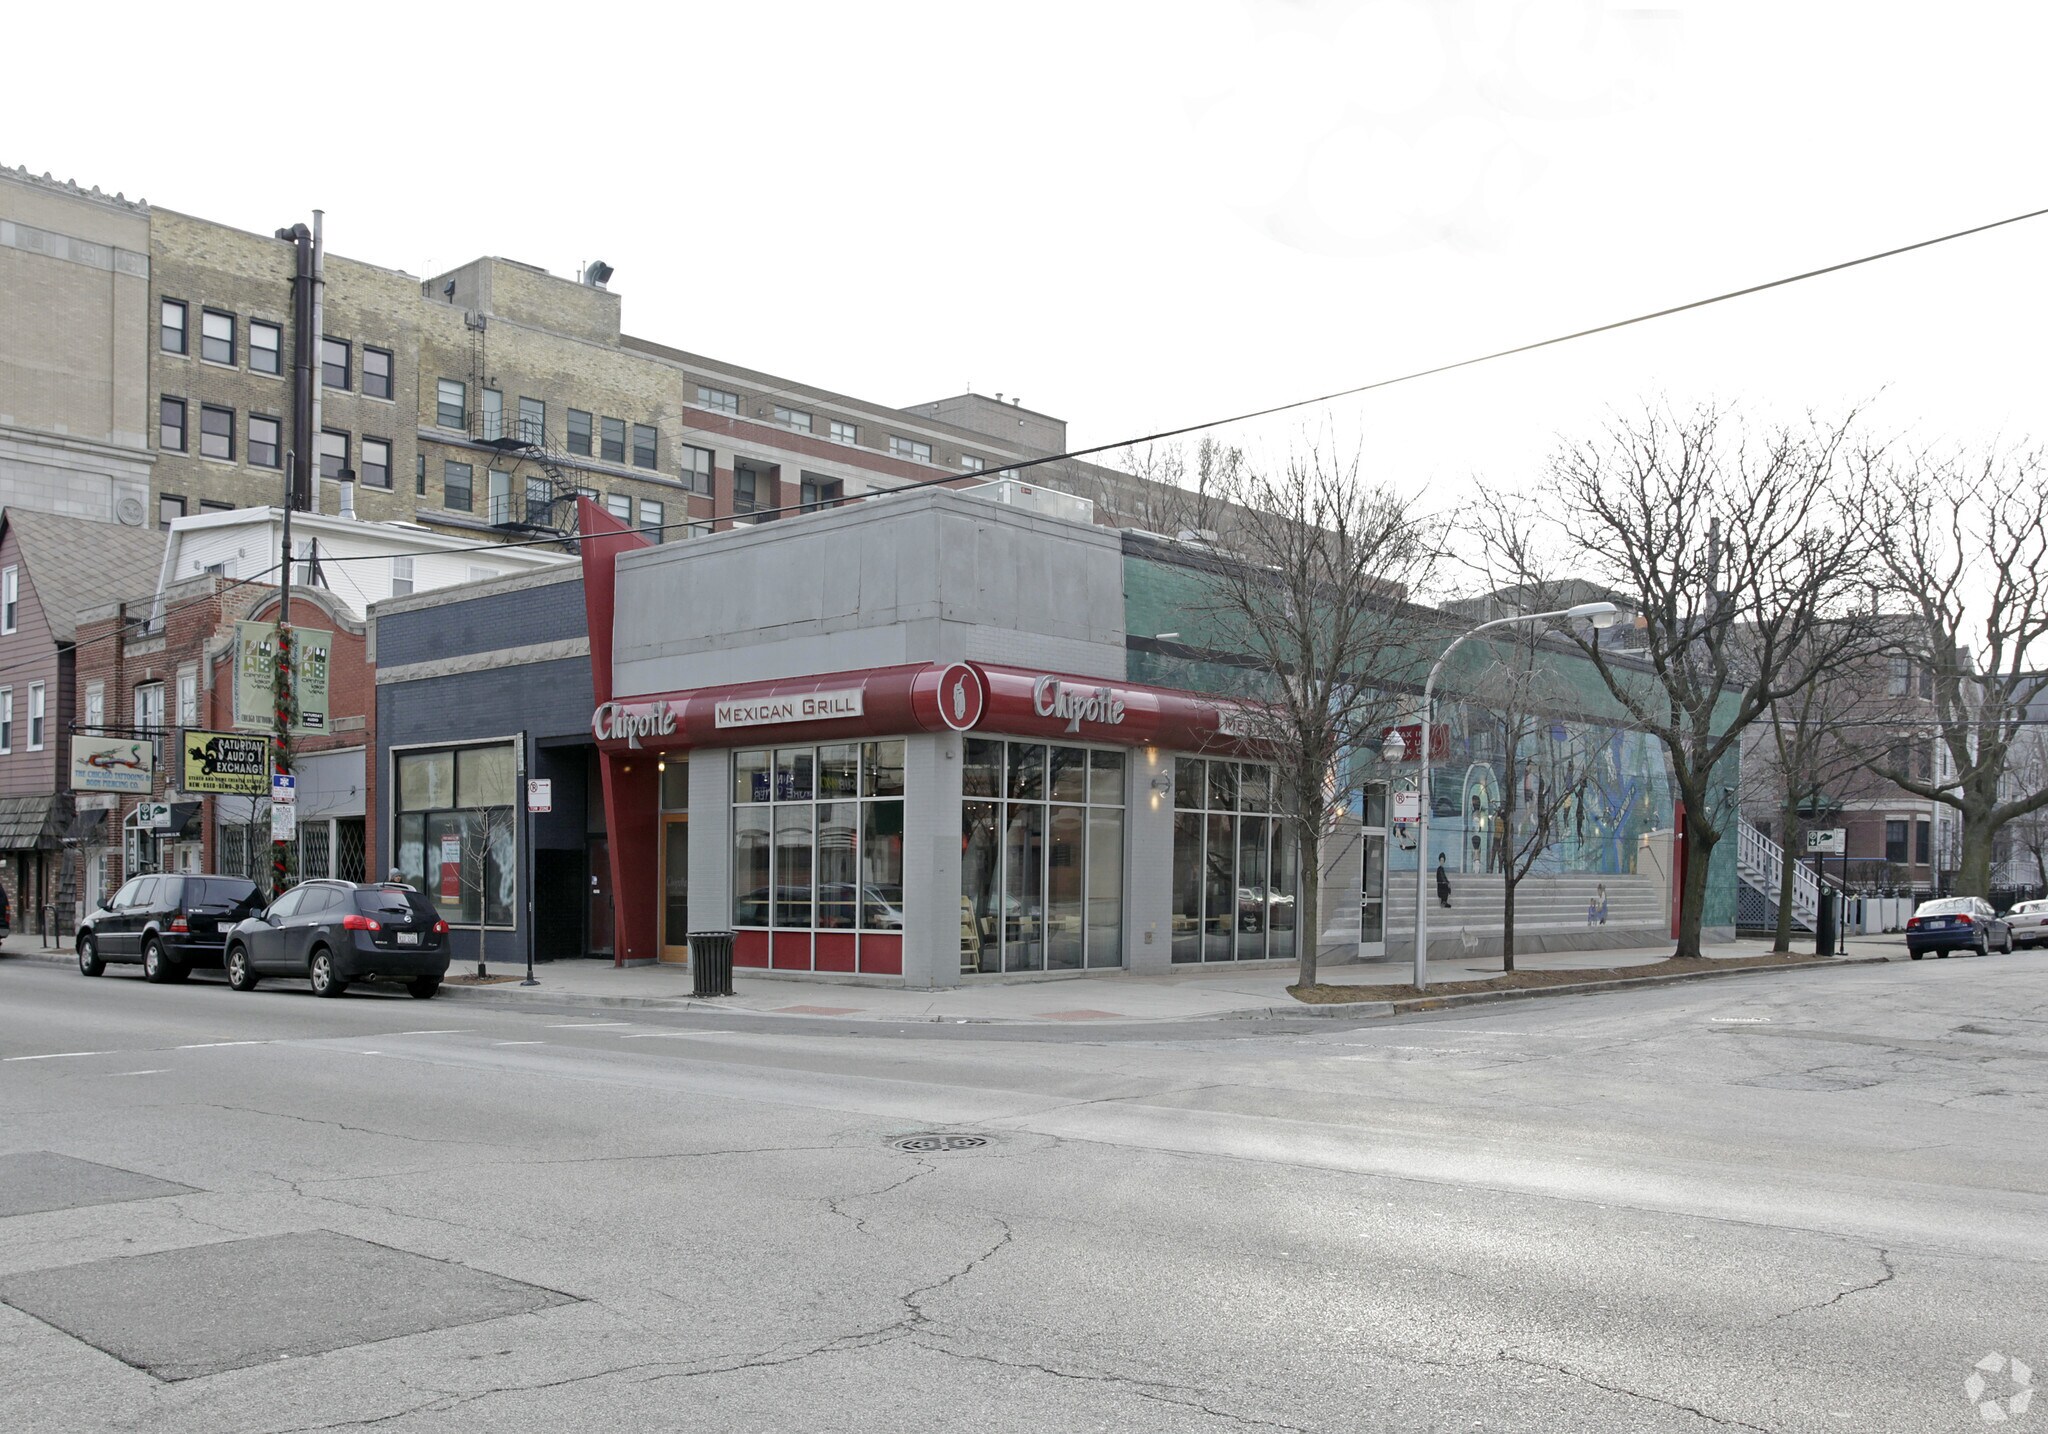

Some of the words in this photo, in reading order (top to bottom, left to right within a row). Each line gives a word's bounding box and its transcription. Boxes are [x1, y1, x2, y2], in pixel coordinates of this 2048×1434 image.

[718, 703, 793, 723] MEXICAN
[802, 698, 856, 715] GRILL
[1034, 675, 1125, 733] Chipotle
[594, 700, 677, 749] Chipotle
[218, 739, 264, 762] SATURDAY
[226, 751, 255, 762] AUDIO
[87, 771, 113, 779] CHICAGO
[114, 772, 145, 781] TATTOOING
[216, 762, 264, 775] EXCHANGE
[102, 780, 129, 788] PIERCING
